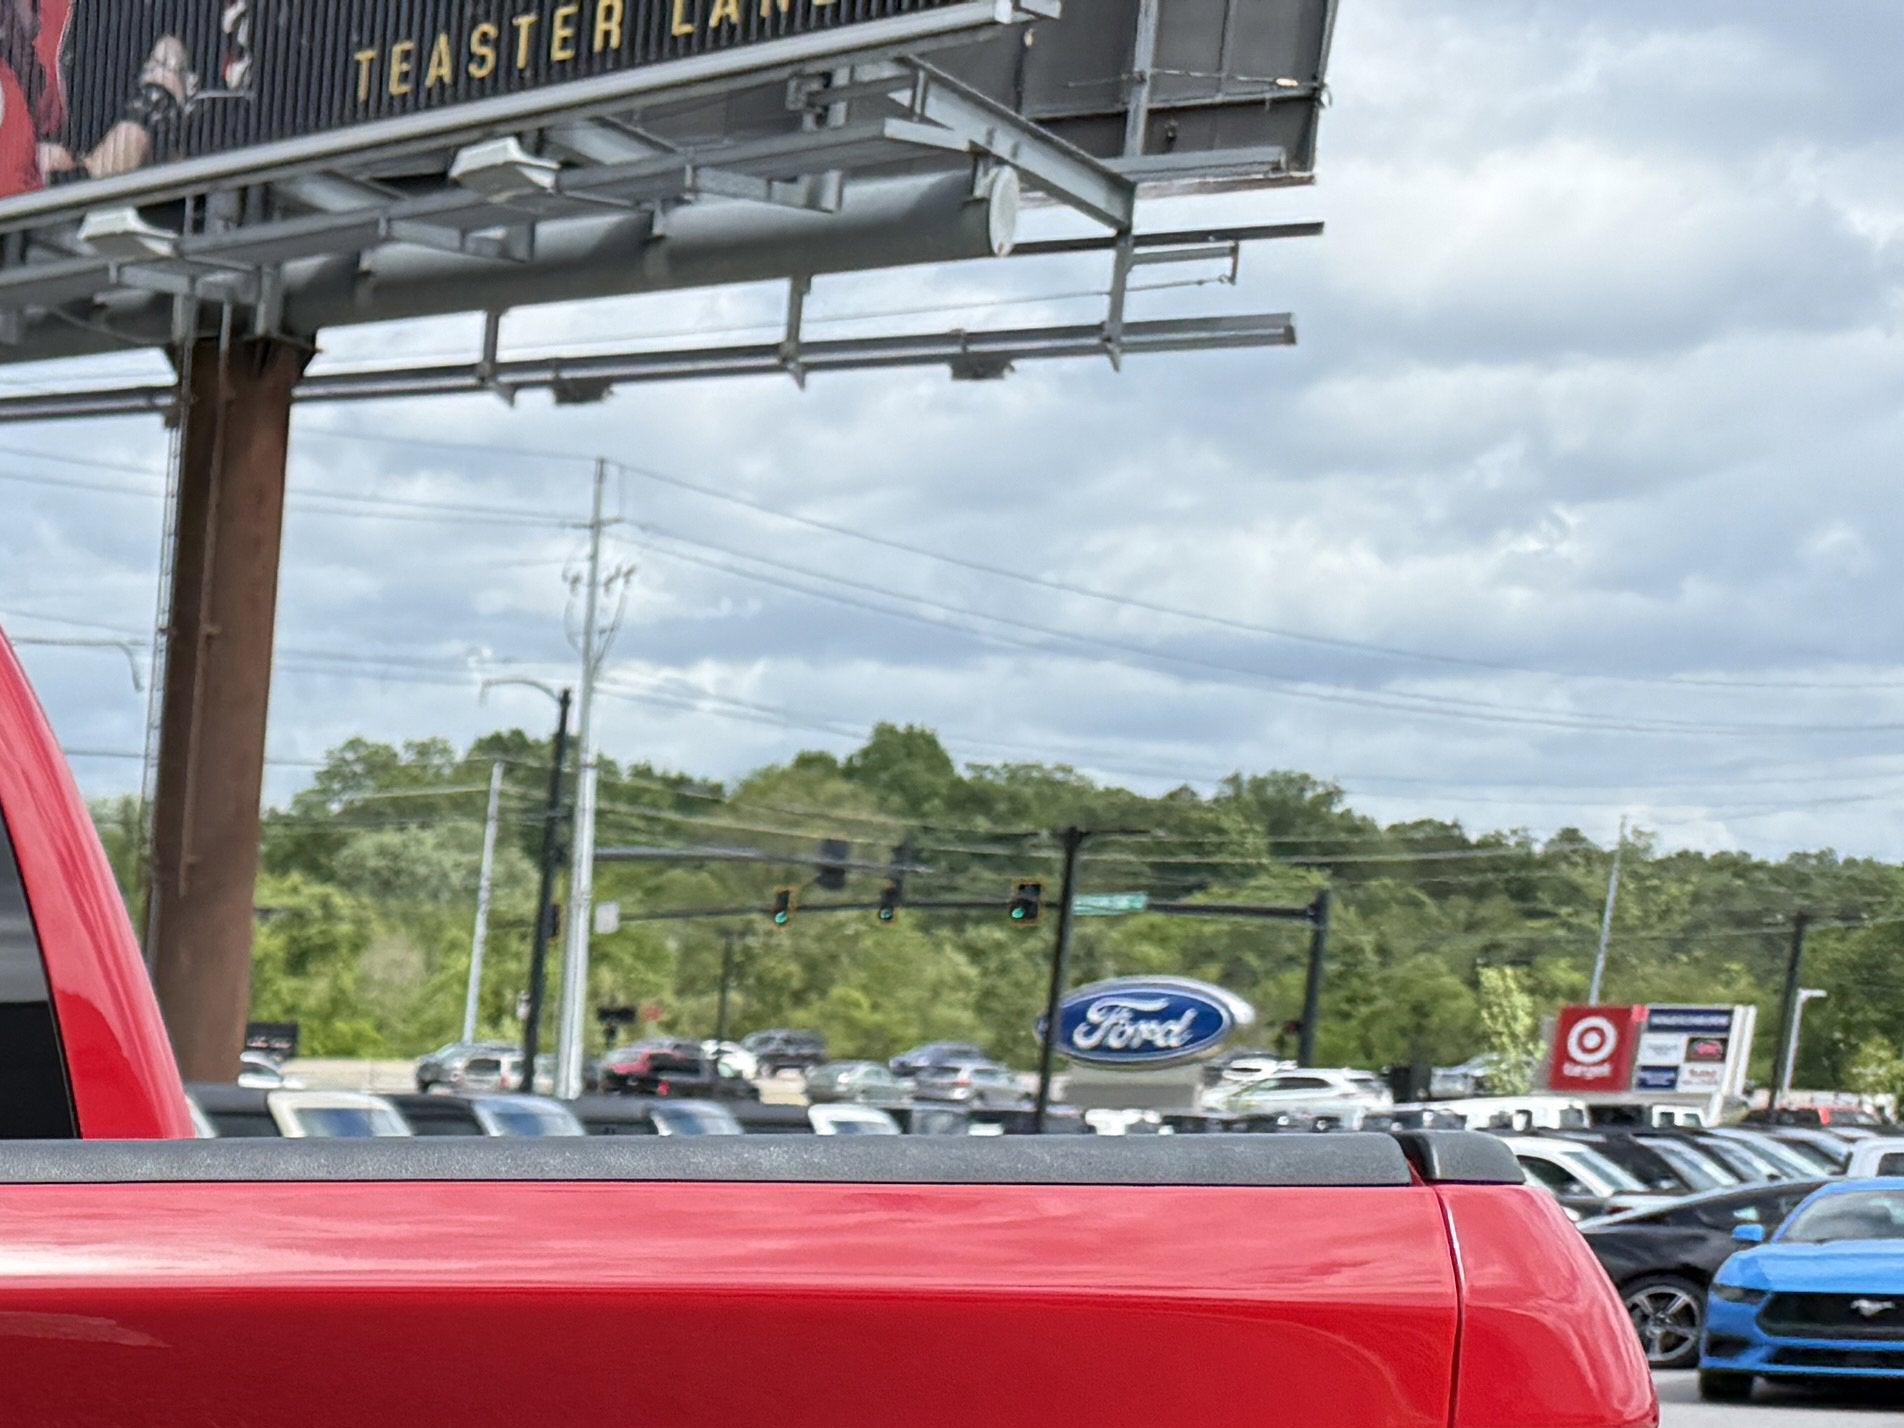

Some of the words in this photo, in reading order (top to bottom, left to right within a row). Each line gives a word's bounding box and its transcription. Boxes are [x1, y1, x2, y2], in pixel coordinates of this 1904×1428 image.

[355, 0, 623, 101] TEASTER
[672, 0, 837, 36] LA
[1072, 997, 1198, 1050] Ford
